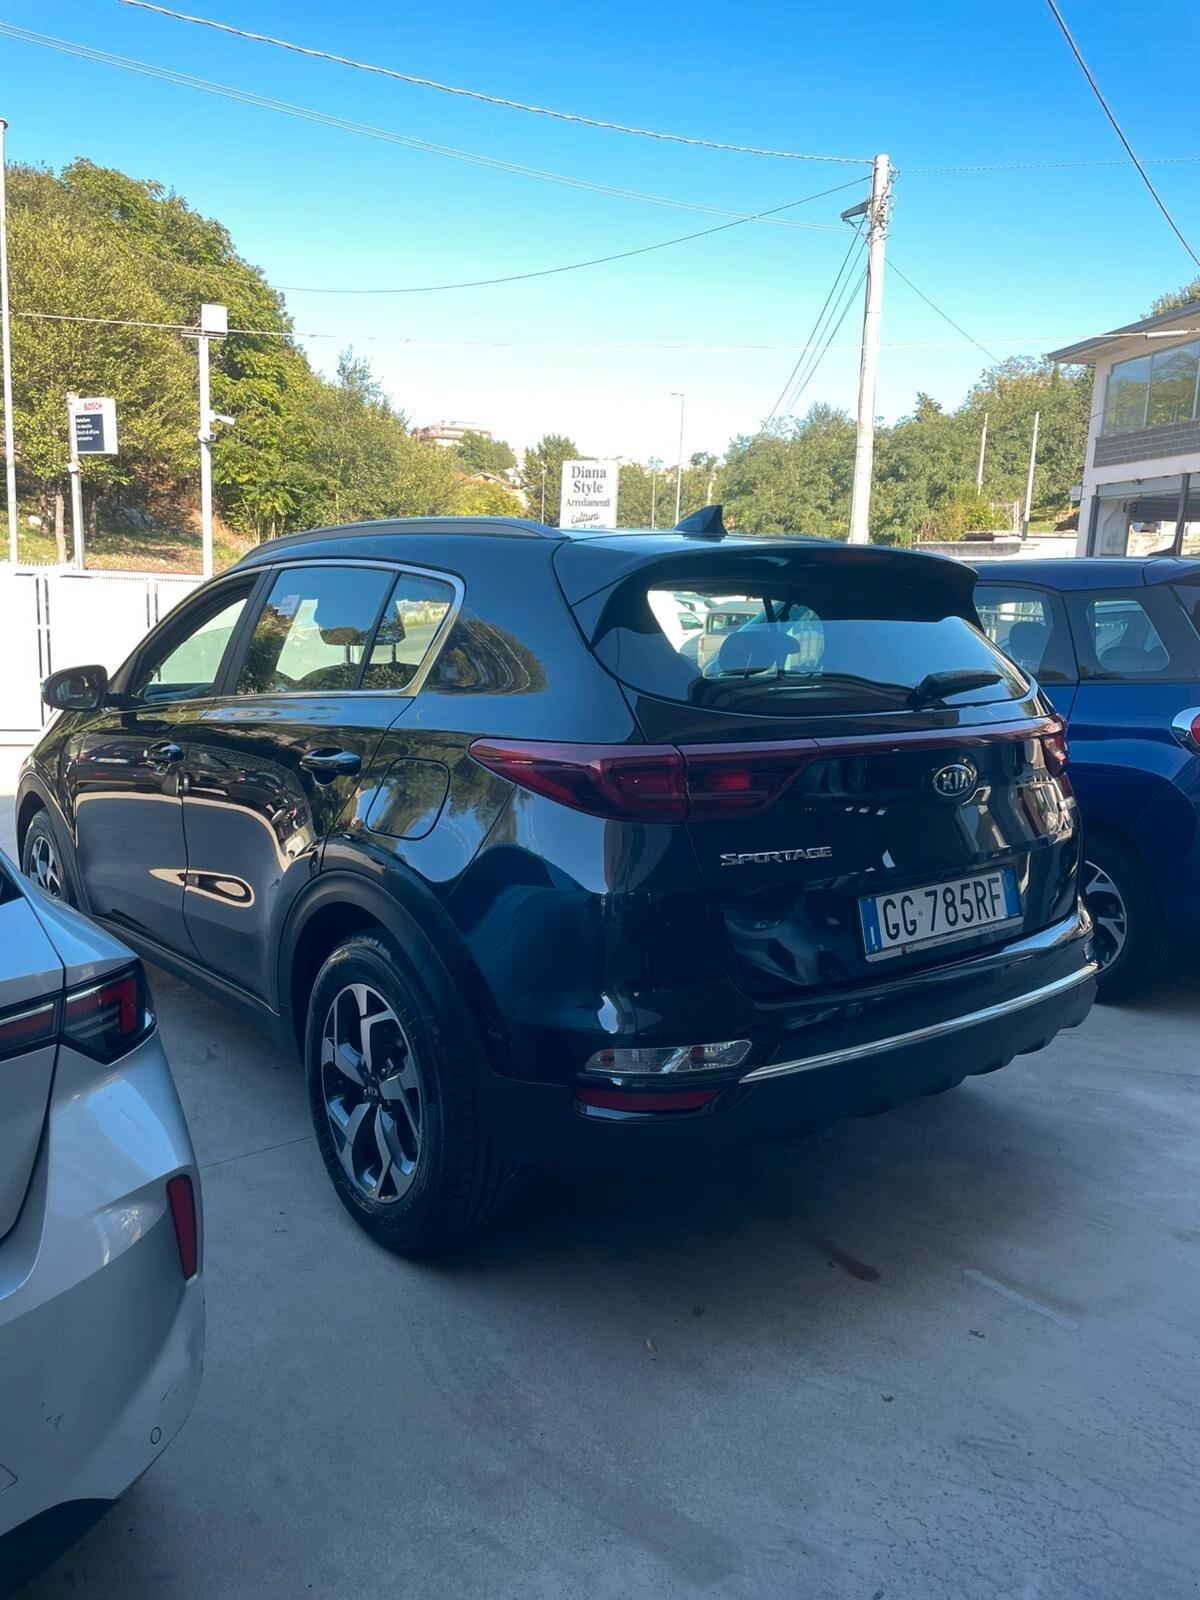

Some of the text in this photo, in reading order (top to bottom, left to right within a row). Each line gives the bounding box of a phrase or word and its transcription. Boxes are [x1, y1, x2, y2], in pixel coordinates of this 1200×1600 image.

[83, 402, 103, 411] BOSCH
[571, 466, 607, 479] Diana
[573, 480, 603, 496] Style
[566, 498, 611, 507] Arredamenti
[720, 846, 833, 866] SPORTAGE
